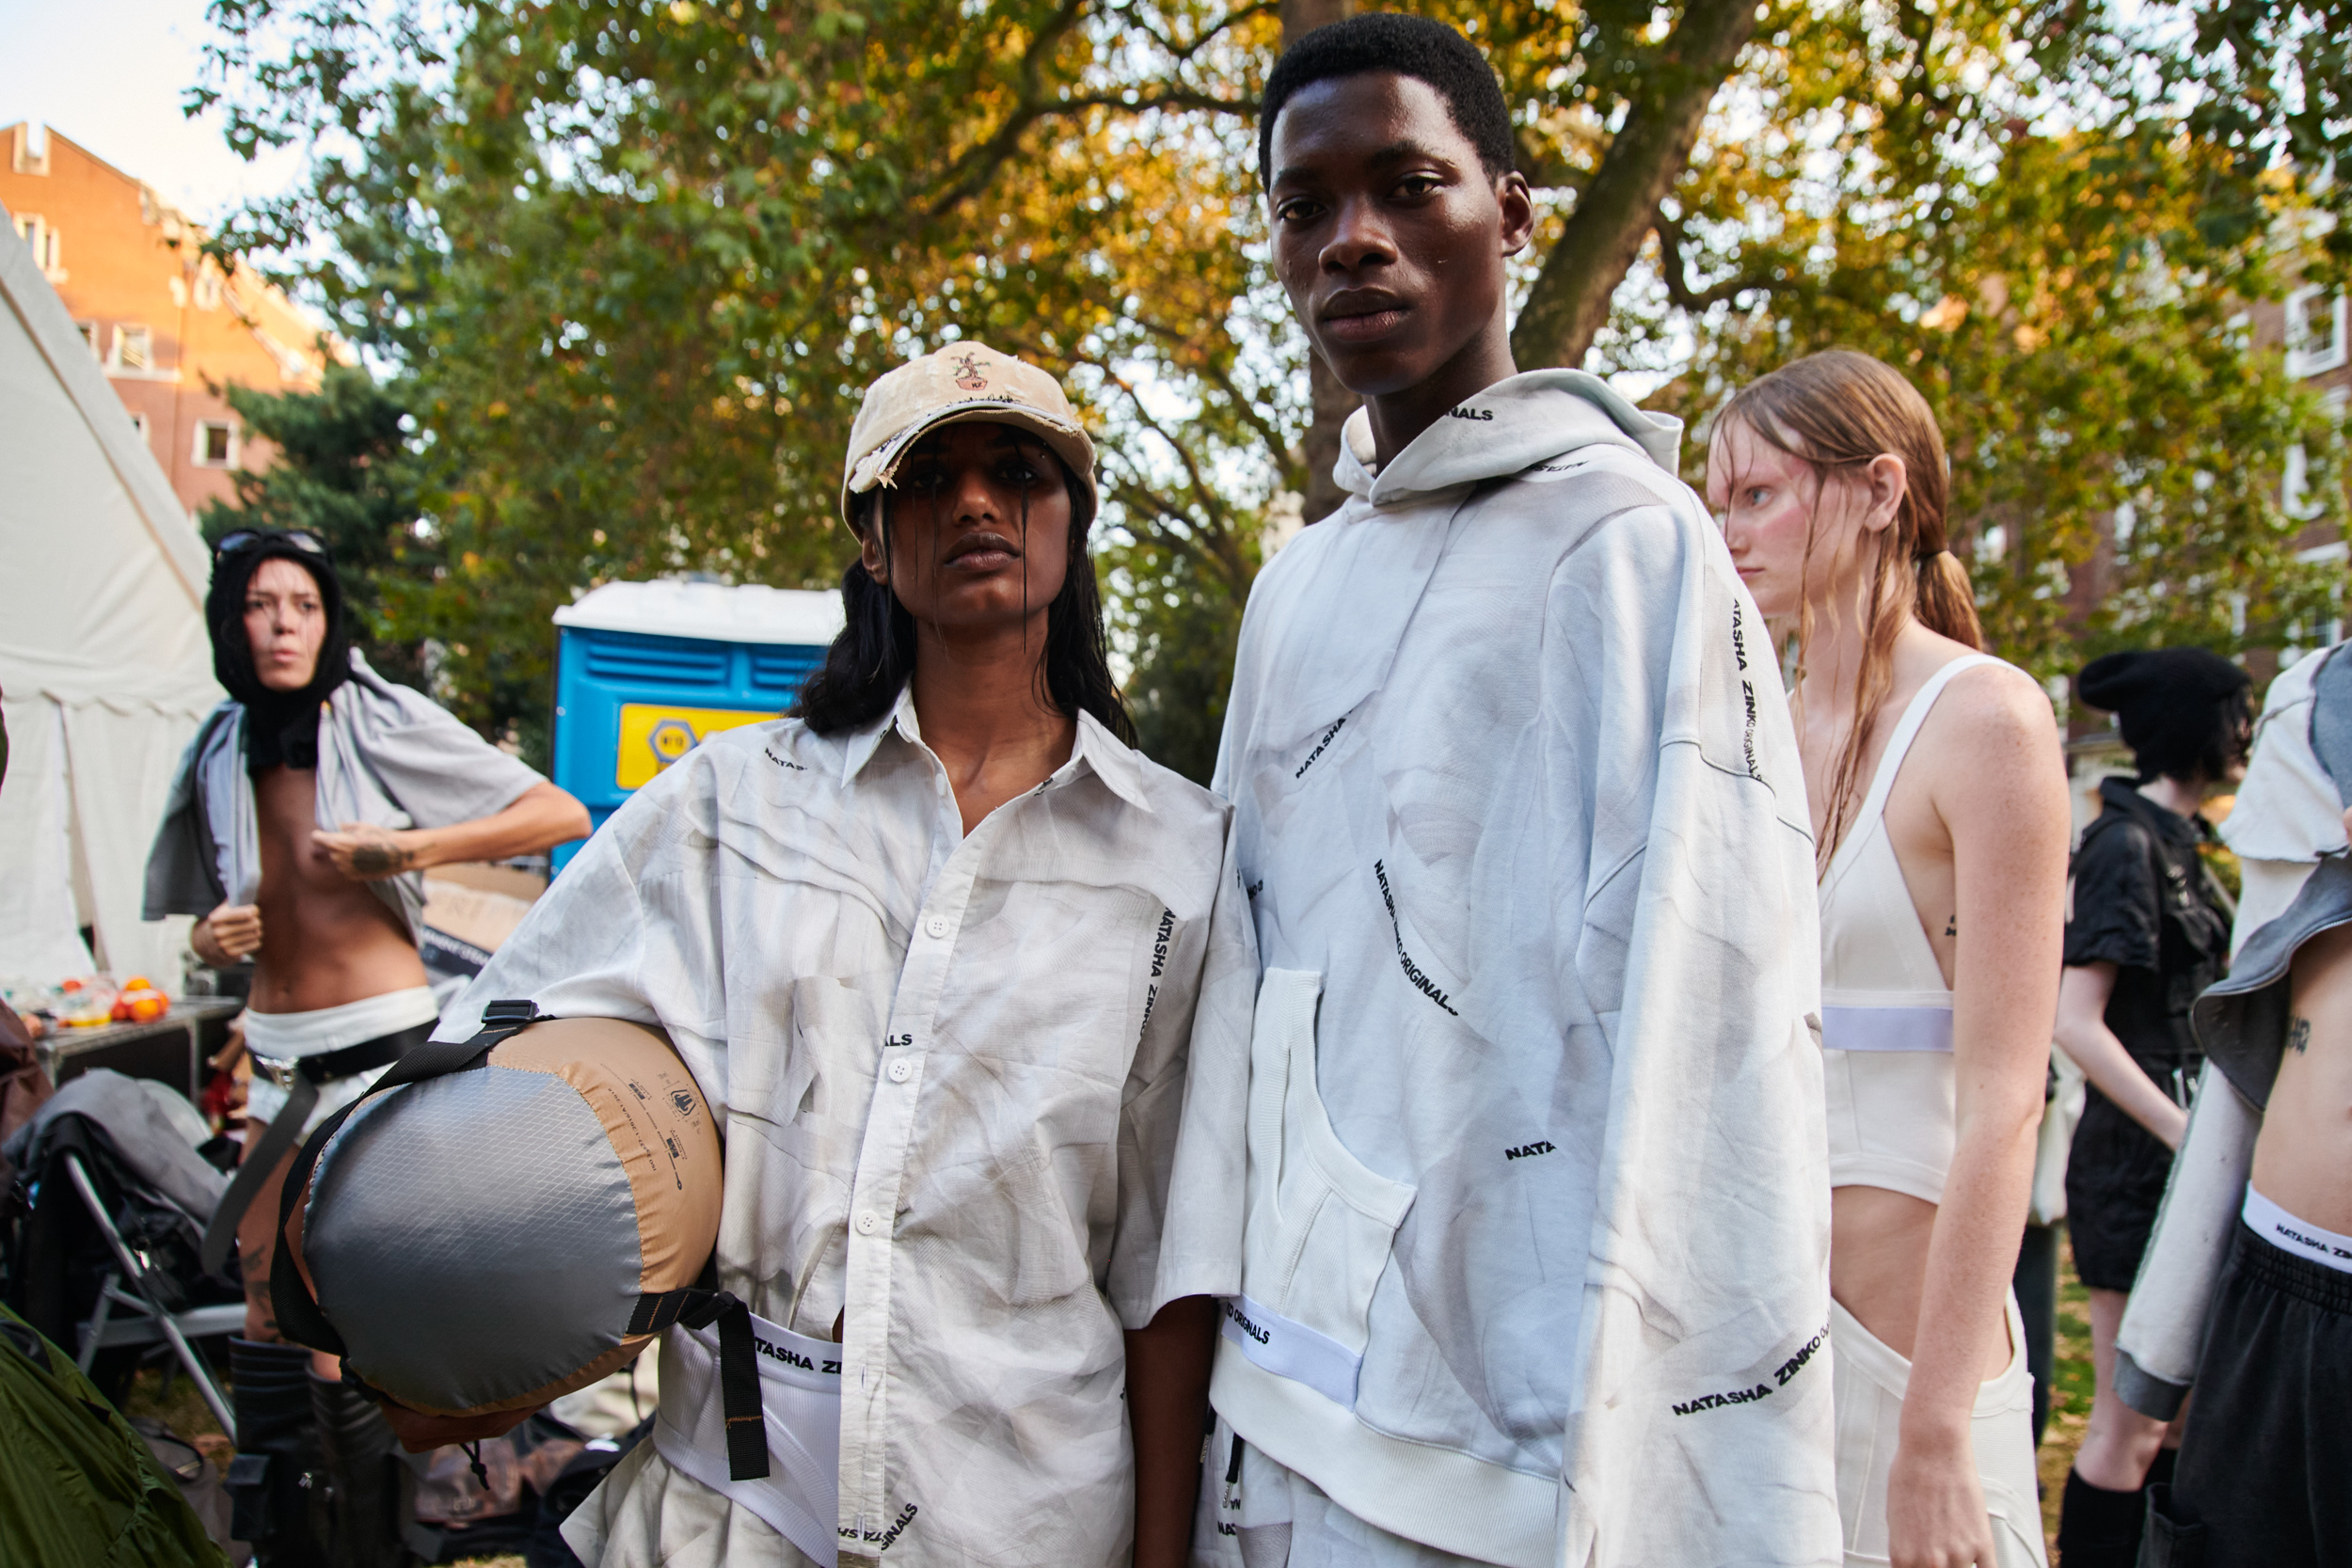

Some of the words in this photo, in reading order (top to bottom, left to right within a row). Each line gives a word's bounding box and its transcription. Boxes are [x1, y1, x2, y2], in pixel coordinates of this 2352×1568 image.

[1742, 679, 1756, 727] ZINKO
[1295, 718, 1346, 779] NATASHA
[1375, 859, 1396, 921] NATASHA
[1151, 907, 1176, 977] NATASHA
[2276, 1223, 2329, 1253] NATASHA
[755, 1337, 814, 1370] TASHA
[1672, 1384, 1773, 1416] NATASHA
[1773, 1336, 1820, 1386] ZINKO
[1217, 1520, 1236, 1536] NA
